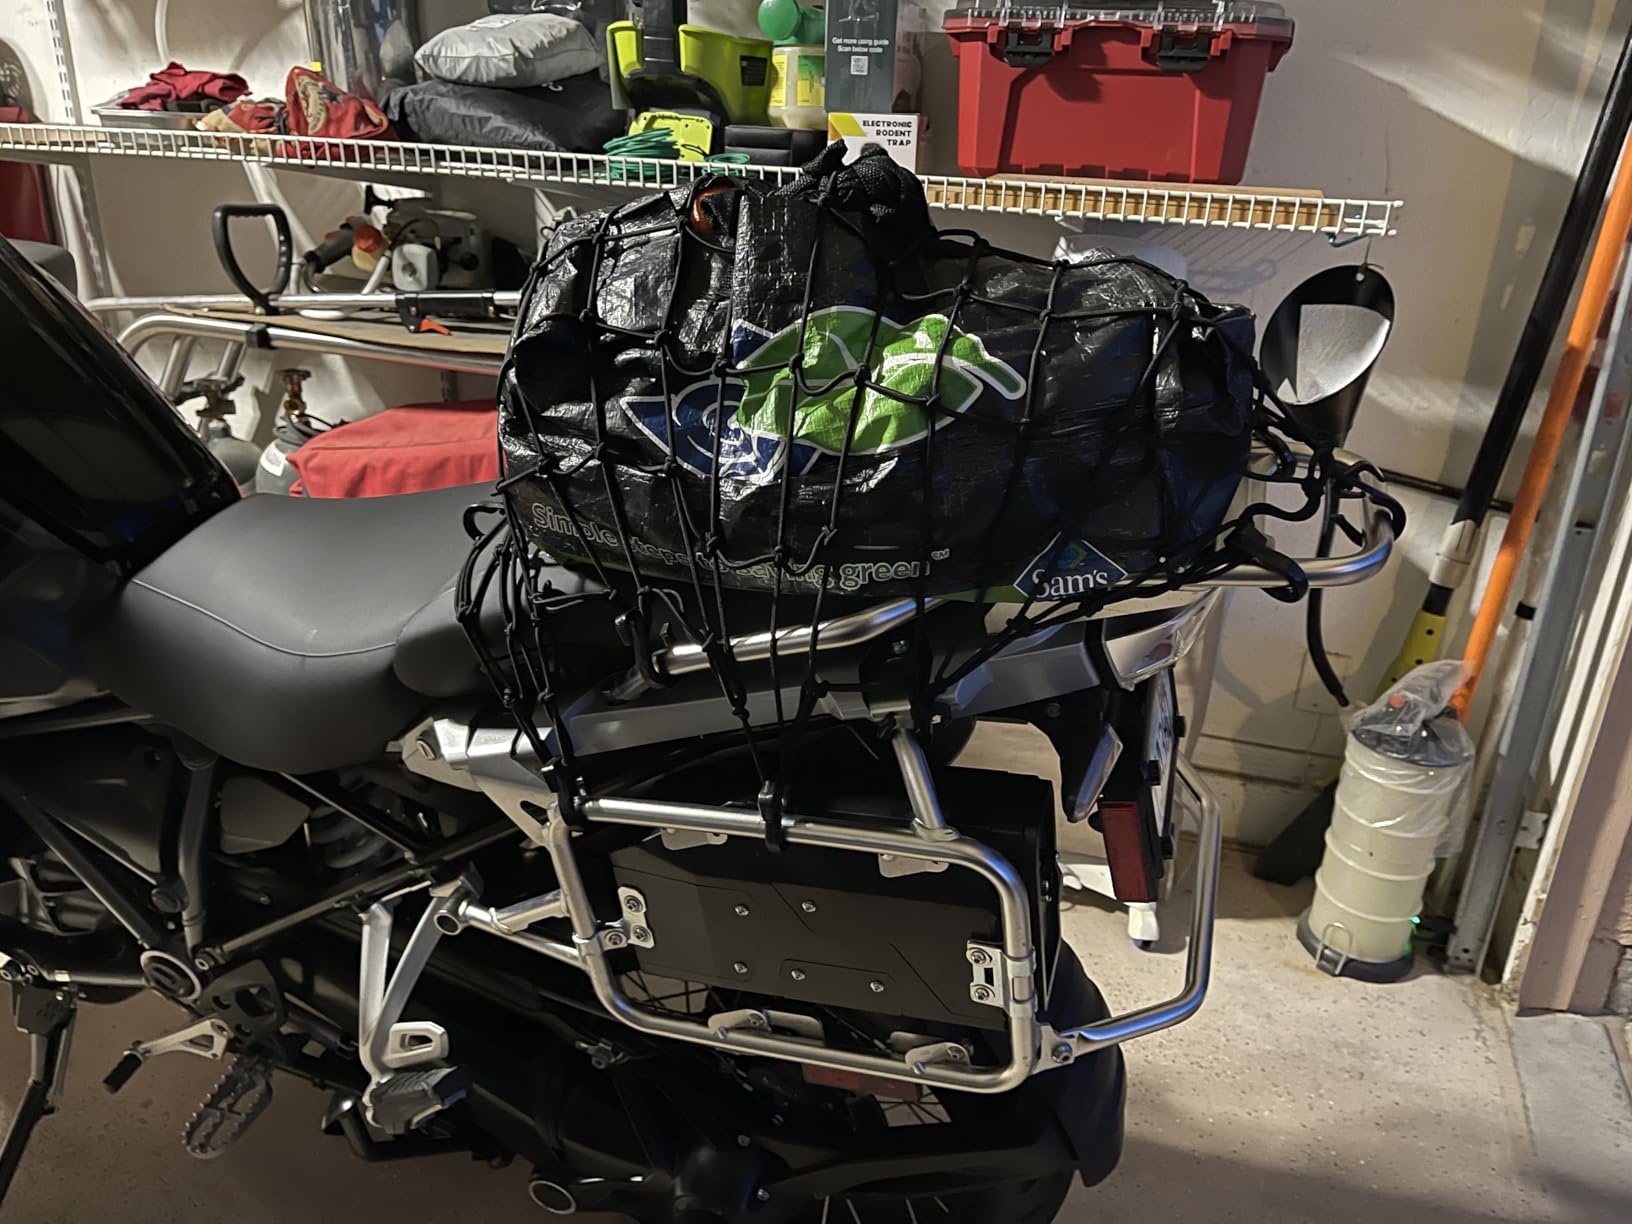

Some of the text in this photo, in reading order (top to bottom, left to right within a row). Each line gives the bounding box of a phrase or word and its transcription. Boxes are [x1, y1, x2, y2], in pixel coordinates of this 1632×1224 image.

[862, 120, 912, 128] ELECTRONIC
[629, 536, 691, 565] teps
[839, 561, 930, 591] green
[1031, 568, 1110, 599] Sam's
